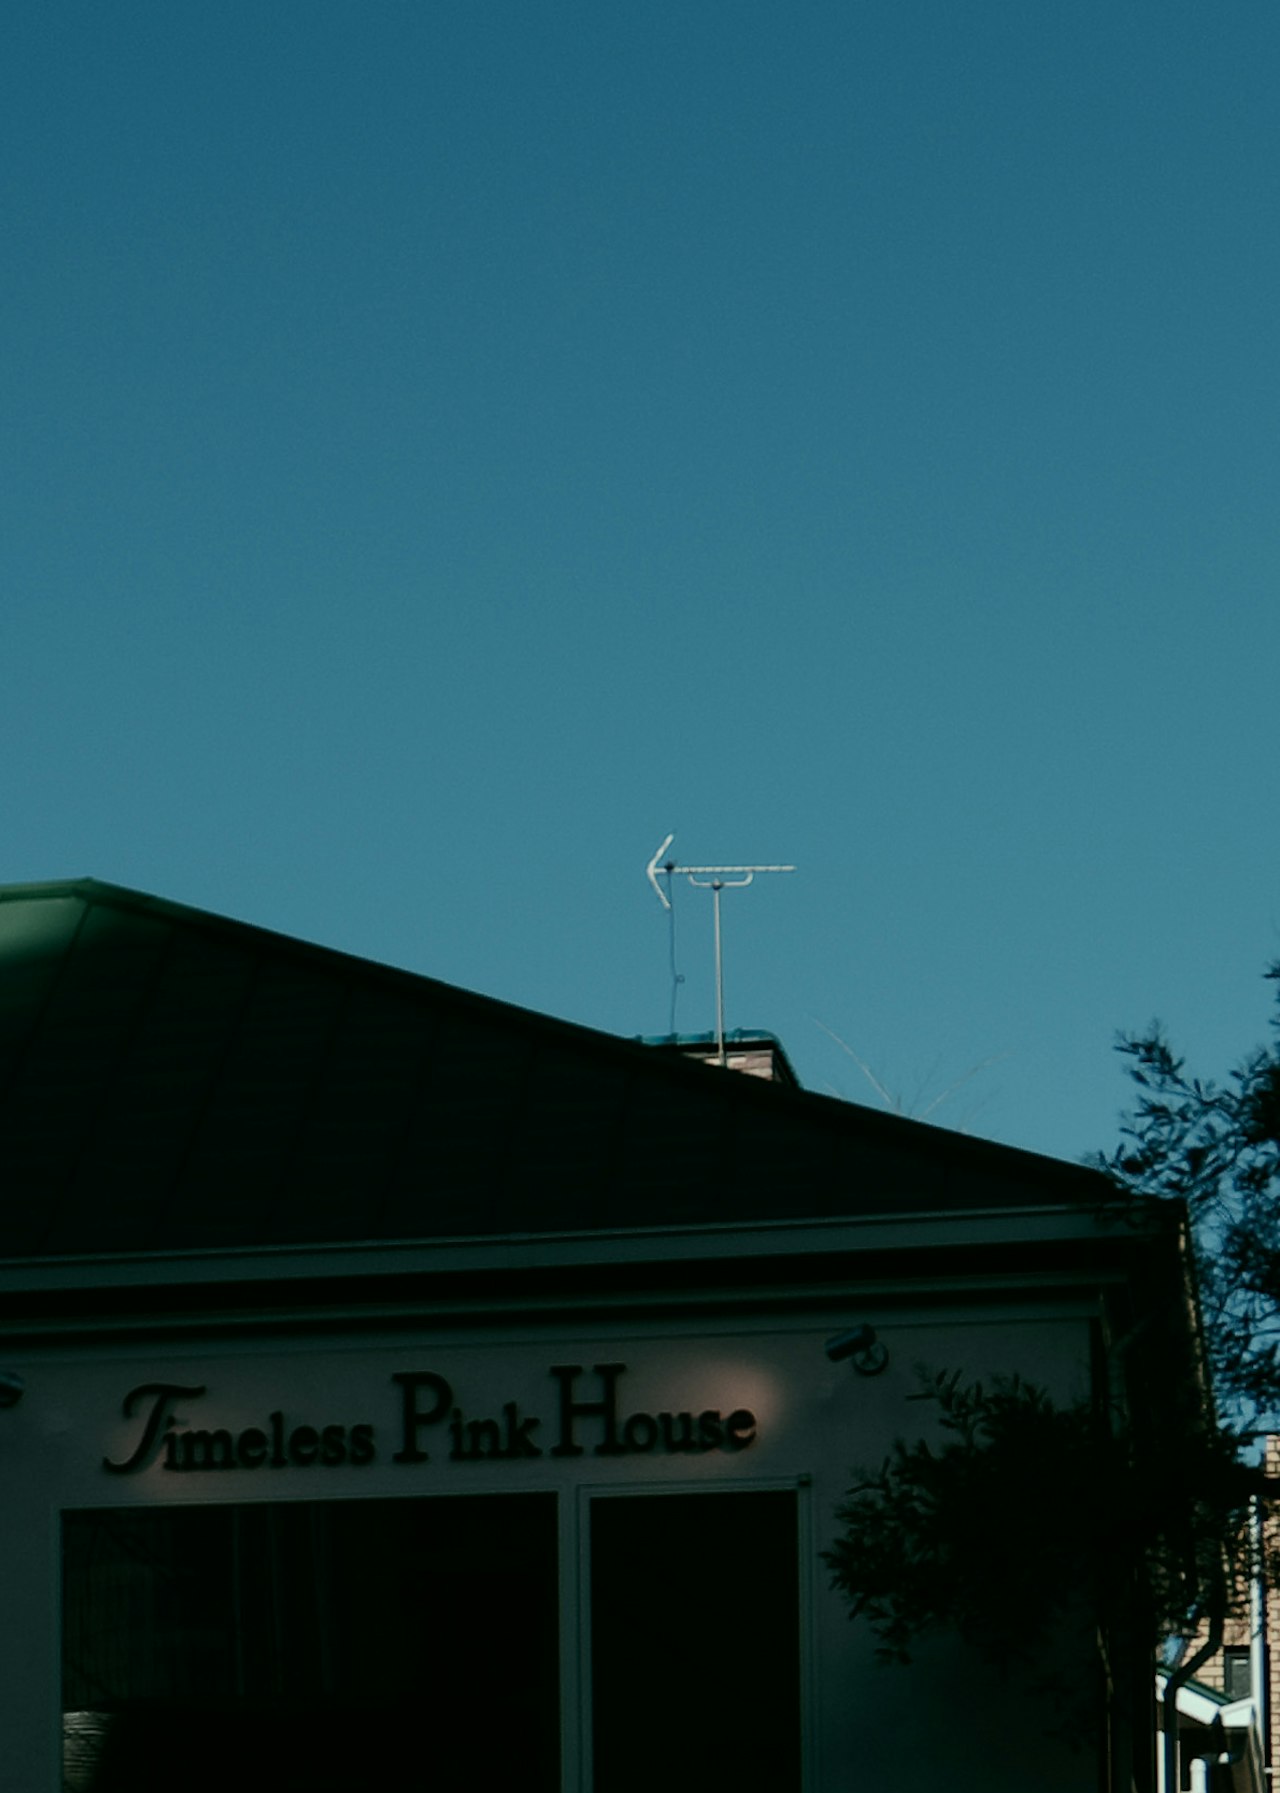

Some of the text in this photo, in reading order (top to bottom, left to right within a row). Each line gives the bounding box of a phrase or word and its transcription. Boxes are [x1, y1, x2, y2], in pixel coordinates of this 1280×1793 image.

[101, 1362, 758, 1476] Timeless Pink House
